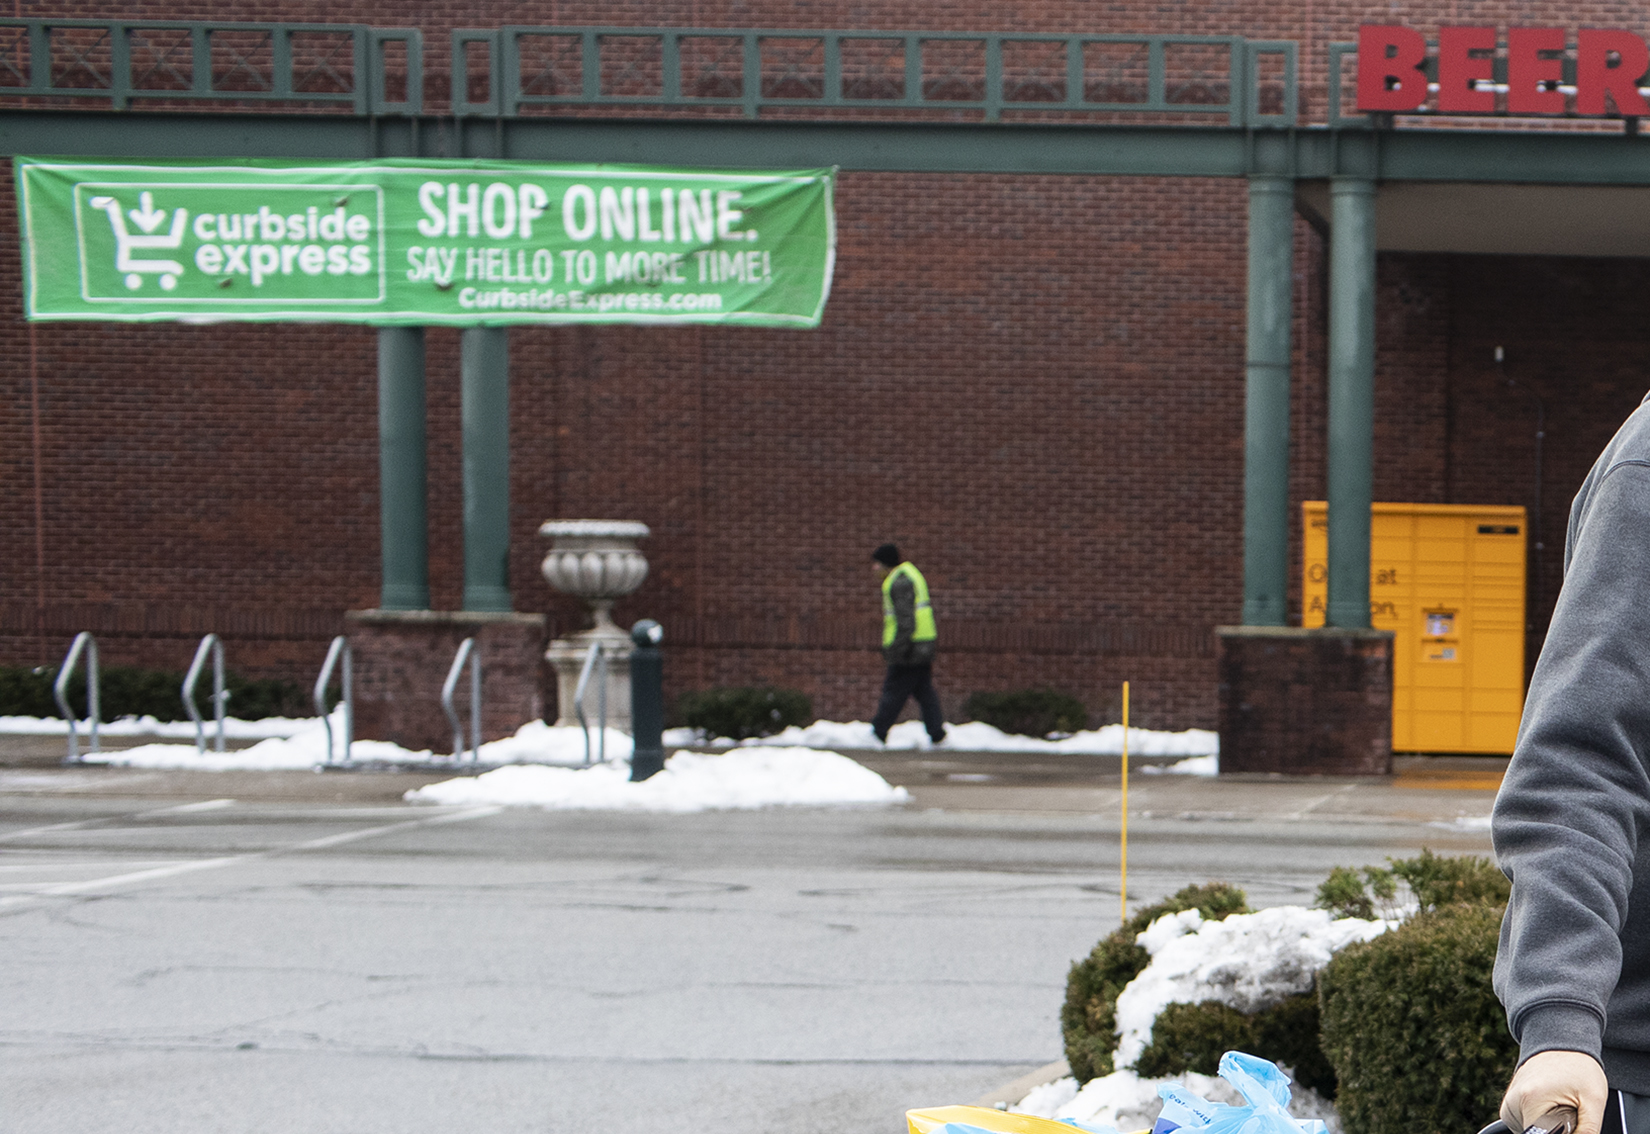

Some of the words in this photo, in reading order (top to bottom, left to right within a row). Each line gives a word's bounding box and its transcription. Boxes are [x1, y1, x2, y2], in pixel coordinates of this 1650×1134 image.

[193, 205, 371, 243] curbside
[417, 181, 547, 242] SHOP
[562, 184, 760, 244] ONLINE.
[194, 241, 372, 286] express
[406, 247, 461, 283] SAY
[465, 248, 556, 285] HELLO
[560, 249, 598, 286] TO
[605, 248, 687, 286] MORE
[695, 250, 772, 285] TIME!
[459, 286, 723, 312] CurbsideExpress.com
